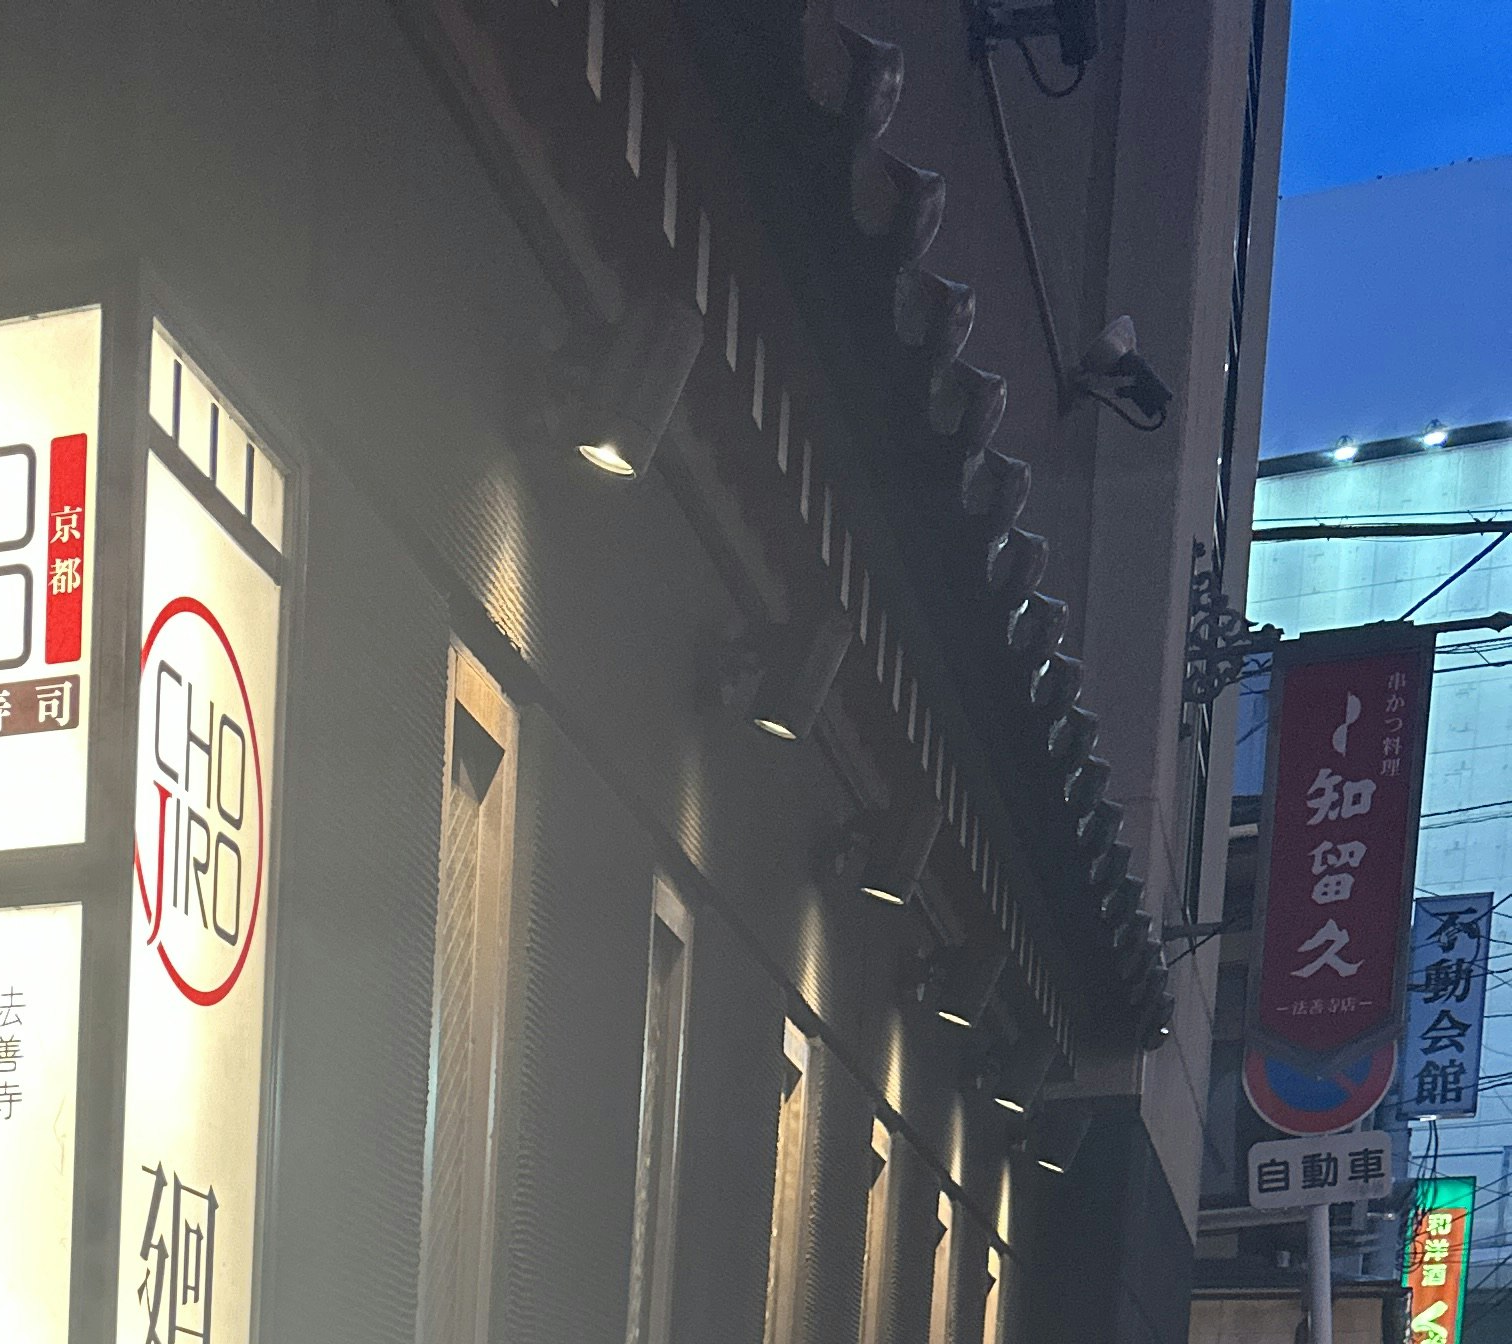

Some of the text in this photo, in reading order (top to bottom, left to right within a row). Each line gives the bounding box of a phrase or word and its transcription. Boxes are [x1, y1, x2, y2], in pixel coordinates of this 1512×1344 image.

[47, 506, 84, 596] 京都
[154, 659, 247, 831] CHO
[146, 779, 243, 948] JIRO
[1289, 767, 1378, 979] 知留久
[1412, 906, 1478, 1105] 不動会館
[1257, 1147, 1385, 1194] 自動車
